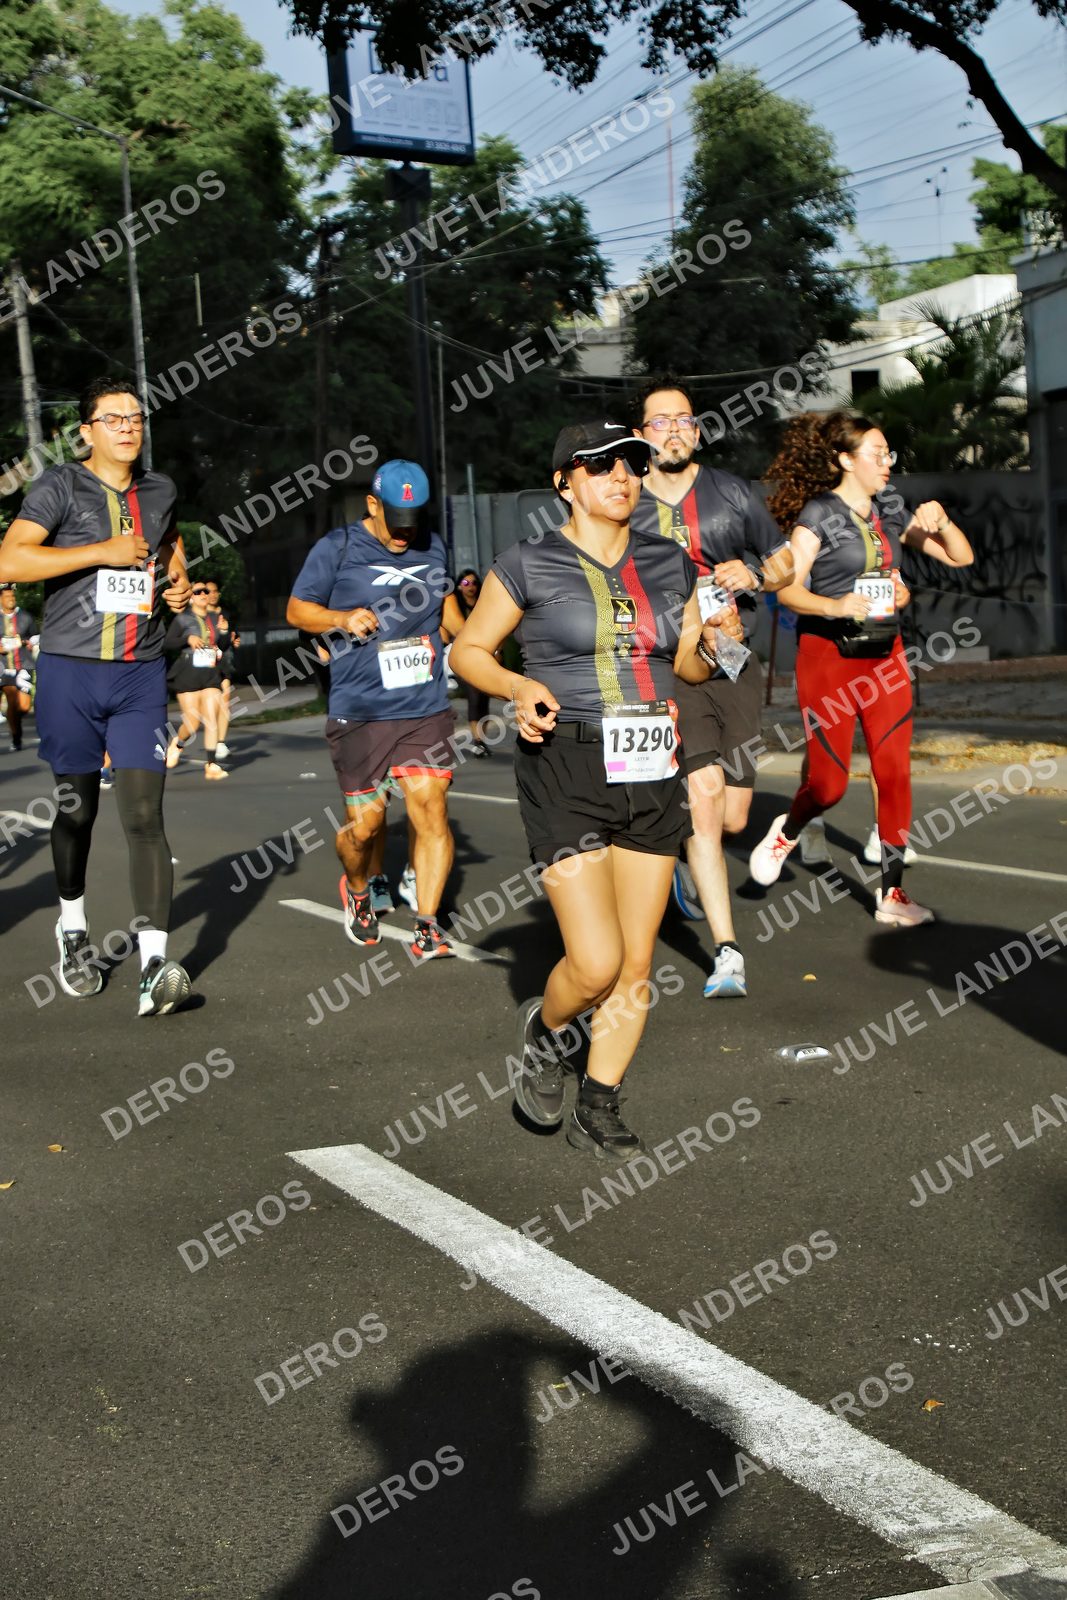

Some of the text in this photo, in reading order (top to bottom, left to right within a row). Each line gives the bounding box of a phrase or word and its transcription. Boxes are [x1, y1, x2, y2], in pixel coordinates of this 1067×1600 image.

[107, 576, 146, 595] 8554
[858, 584, 893, 600] 13319
[384, 651, 429, 671] 11066
[609, 726, 674, 753] 13290
